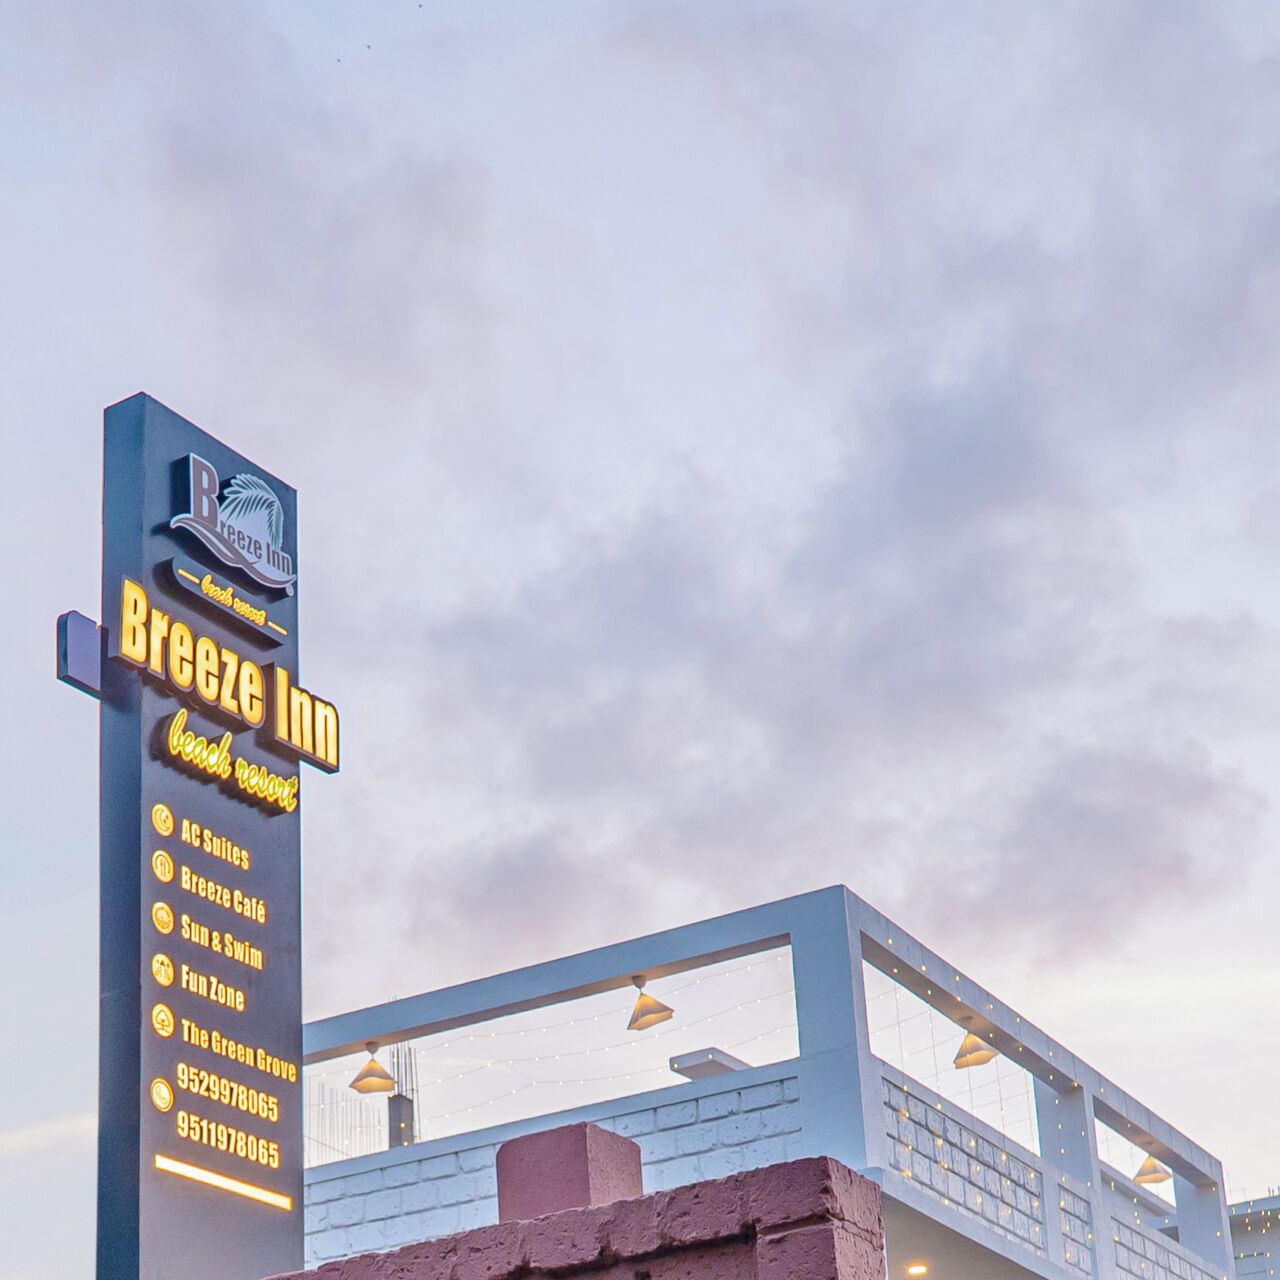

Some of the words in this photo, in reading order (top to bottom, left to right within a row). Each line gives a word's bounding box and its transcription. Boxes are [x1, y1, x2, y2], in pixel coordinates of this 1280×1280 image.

[190, 453, 262, 560] Breeze
[267, 541, 292, 576] Inn
[121, 578, 264, 725] Breeze
[275, 666, 338, 767] Inn
[169, 707, 233, 780] beach
[234, 757, 299, 813] resort
[181, 818, 201, 848] AC
[203, 828, 250, 870] Suites
[181, 865, 231, 908] Breeze
[233, 889, 267, 924] Café
[181, 914, 209, 947] Sun
[211, 931, 222, 953] &
[224, 933, 264, 970] Swim
[181, 964, 207, 998] Fun
[210, 976, 245, 1011] Zone
[181, 1018, 210, 1049] The
[211, 1030, 255, 1068] Green
[257, 1048, 297, 1083] Grove
[177, 1062, 279, 1122] 9529978065
[177, 1110, 280, 1168] 9511978065
